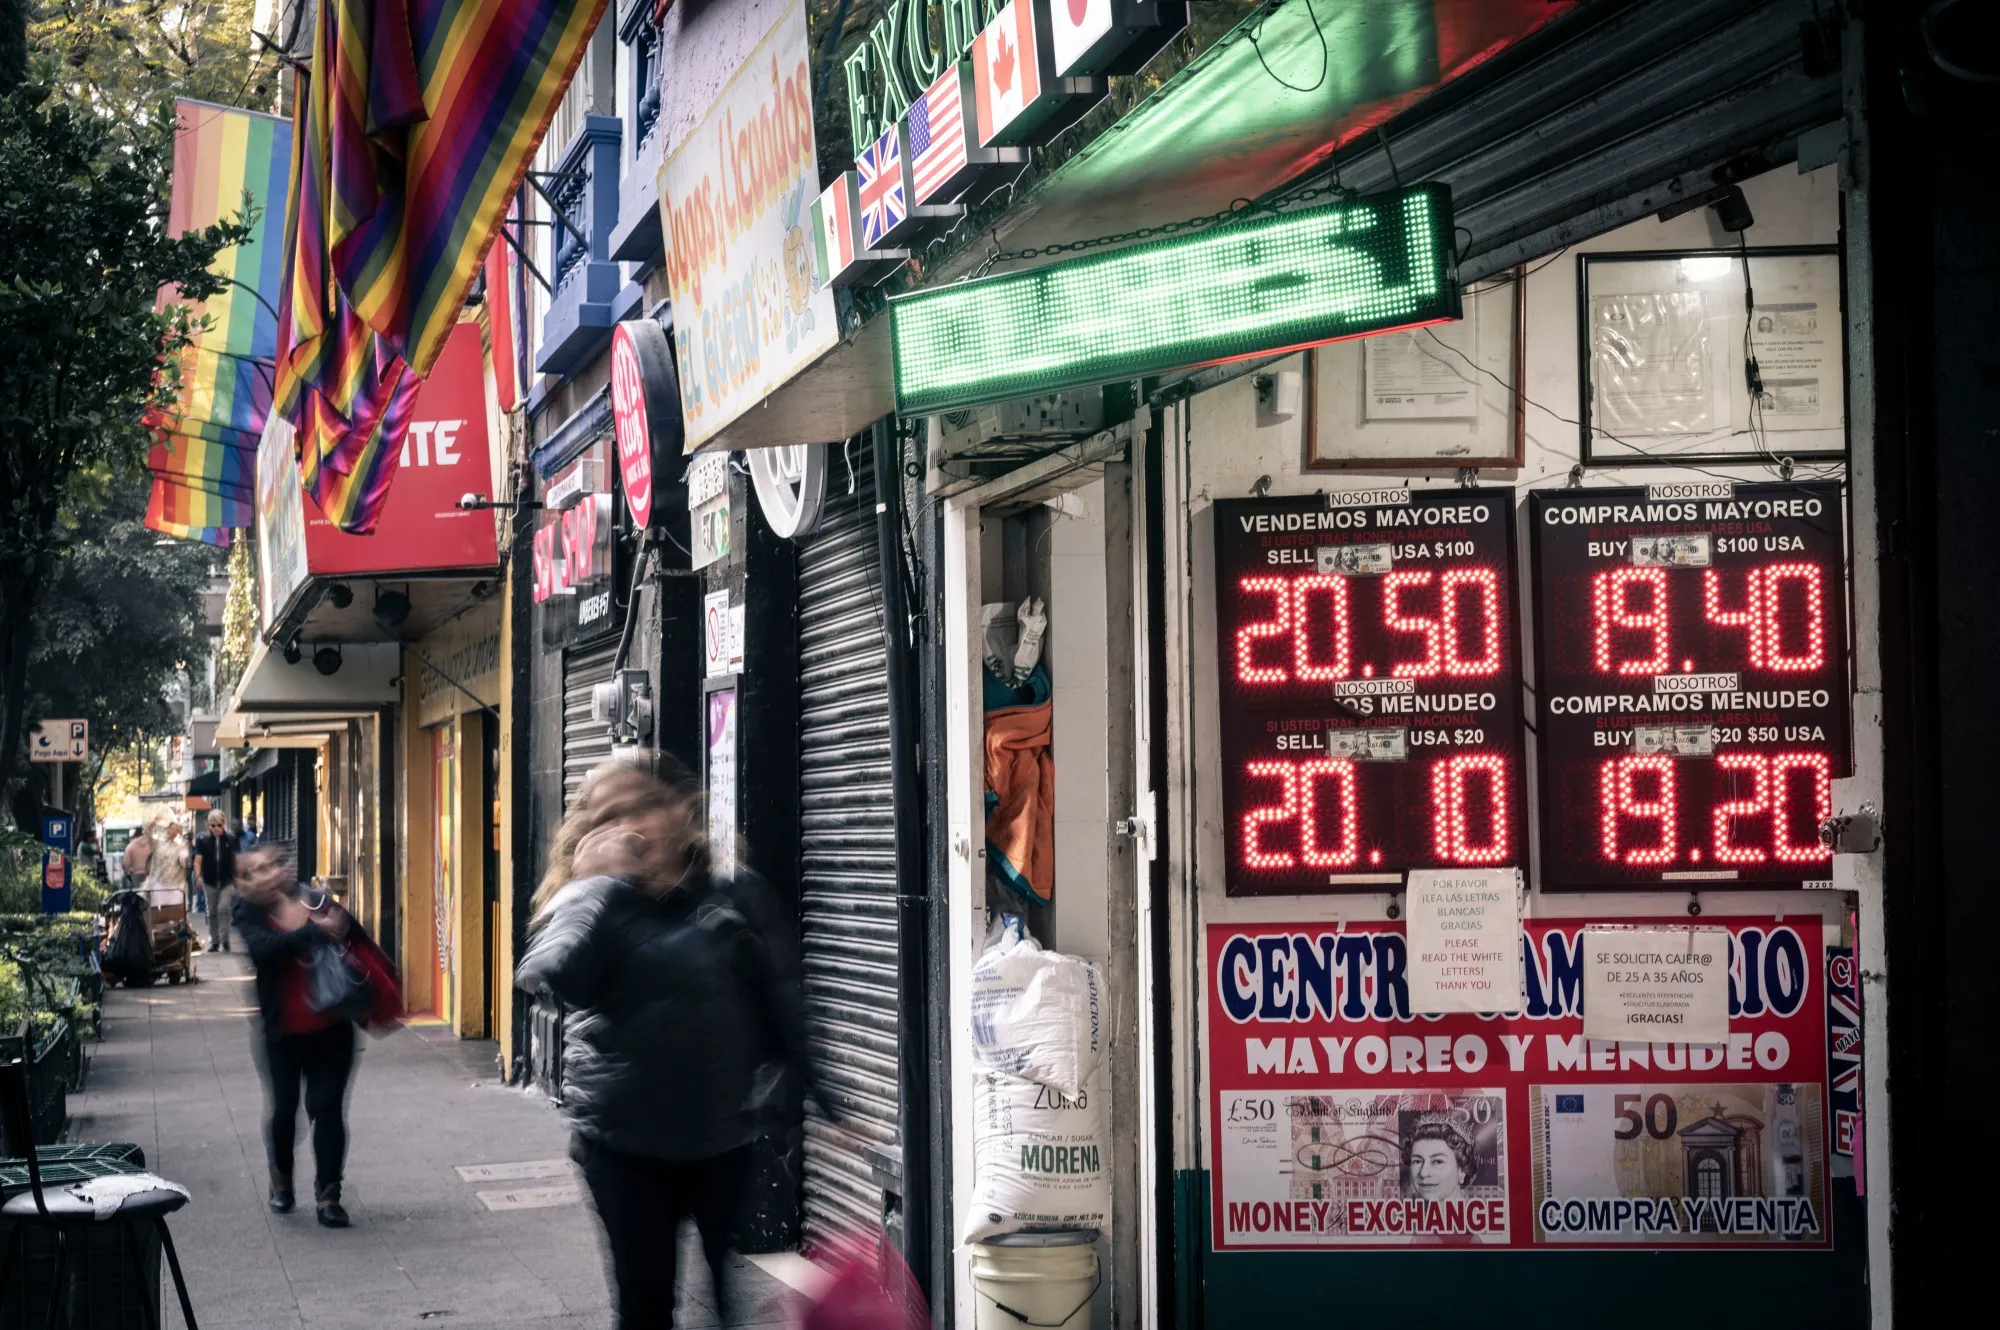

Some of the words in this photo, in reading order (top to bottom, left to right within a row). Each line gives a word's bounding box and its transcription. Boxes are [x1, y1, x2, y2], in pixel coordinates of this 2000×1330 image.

[664, 170, 717, 308] Jugos
[400, 419, 463, 468] ITE
[1331, 489, 1409, 507] NOSOTROS
[1650, 483, 1731, 499] NOSOTROS
[1240, 510, 1368, 534] VENDEMOS
[1376, 505, 1491, 528] MAYOREO
[1544, 503, 1698, 525] COMPRAMOS
[1704, 498, 1823, 521] MAYOREO
[1275, 534, 1315, 547] USTED
[1317, 533, 1349, 546] TRAE
[1352, 530, 1405, 544] MONEDA
[1406, 527, 1470, 541] NACIONAL
[1746, 522, 1772, 534] USA
[533, 520, 556, 604] SEX
[561, 494, 598, 588] SHOP
[1267, 549, 1315, 565] SELL
[1391, 543, 1431, 560] USA
[1434, 540, 1475, 559] $100
[1588, 541, 1628, 557] BUY
[1717, 537, 1758, 553] $100
[1764, 536, 1805, 552] USA
[1236, 568, 1501, 683] 20.50
[1593, 562, 1824, 674] 19.40
[1336, 681, 1414, 695] NOSOTROS
[1656, 675, 1737, 691] NOSOTROS
[1381, 692, 1496, 714] MENUDEO
[1550, 692, 1704, 715] COMPRAMOS
[1711, 689, 1830, 711] MENUDEO
[1266, 720, 1279, 733] SI
[1281, 718, 1321, 732] USTED
[1325, 717, 1356, 731] TRAE
[1359, 714, 1412, 729] MONEDA
[1413, 712, 1477, 727] NACIONAL
[1611, 715, 1653, 729] USTED
[1754, 711, 1781, 725] USA
[1276, 734, 1324, 750] SELL
[1410, 729, 1450, 746] USA
[1453, 728, 1485, 747] $20
[1593, 730, 1634, 747] BUY
[1711, 726, 1743, 744] $20
[1747, 726, 1779, 743] $50
[1784, 725, 1826, 742] USA
[34, 749, 52, 759] Pago
[1243, 754, 1508, 868] 20.10
[1600, 752, 1834, 864] 19.20
[1432, 879, 1453, 889] POR
[1455, 879, 1488, 888] FAVOR
[1422, 893, 1444, 904] ¡LEA
[1445, 893, 1463, 903] LAS
[1465, 892, 1500, 902] LETRAS
[1437, 907, 1485, 917] BLANCAS!
[1440, 921, 1483, 931] GRACIAS
[1444, 939, 1479, 948] PLEASE
[1421, 953, 1448, 963] READ
[1451, 953, 1469, 962] THE
[1471, 952, 1504, 962] WHITE
[1596, 953, 1610, 964] SE
[1613, 953, 1663, 965] SOLICITA
[1665, 953, 1713, 966] CAJER@
[1217, 931, 1428, 1025] CENTR
[1441, 966, 1485, 977] LETTERS!
[1607, 971, 1622, 983] DE
[1625, 971, 1639, 983] 25
[1642, 971, 1651, 983] A
[1653, 971, 1668, 983] 35
[1670, 970, 1704, 984] AÑOS
[1435, 981, 1468, 991] THANK
[1470, 980, 1492, 990] YOU
[1086, 960, 1099, 1054] RADICIONAL
[1627, 1013, 1684, 1024] ¡GRACIAS!
[1245, 1034, 1489, 1075] MAYOREO
[1498, 1033, 1535, 1072] Y
[1545, 1031, 1791, 1072] MENUDEO
[1227, 1097, 1275, 1122] £50
[1454, 1097, 1492, 1124] 50
[1613, 1093, 1678, 1140] 50
[1021, 1144, 1100, 1174] MORENA
[1228, 1200, 1332, 1233] MONEY
[1348, 1200, 1505, 1232] EXCHANGE
[1540, 1199, 1679, 1232] COMPRA
[1682, 1199, 1710, 1232] Y
[1709, 1199, 1820, 1232] VENTA
